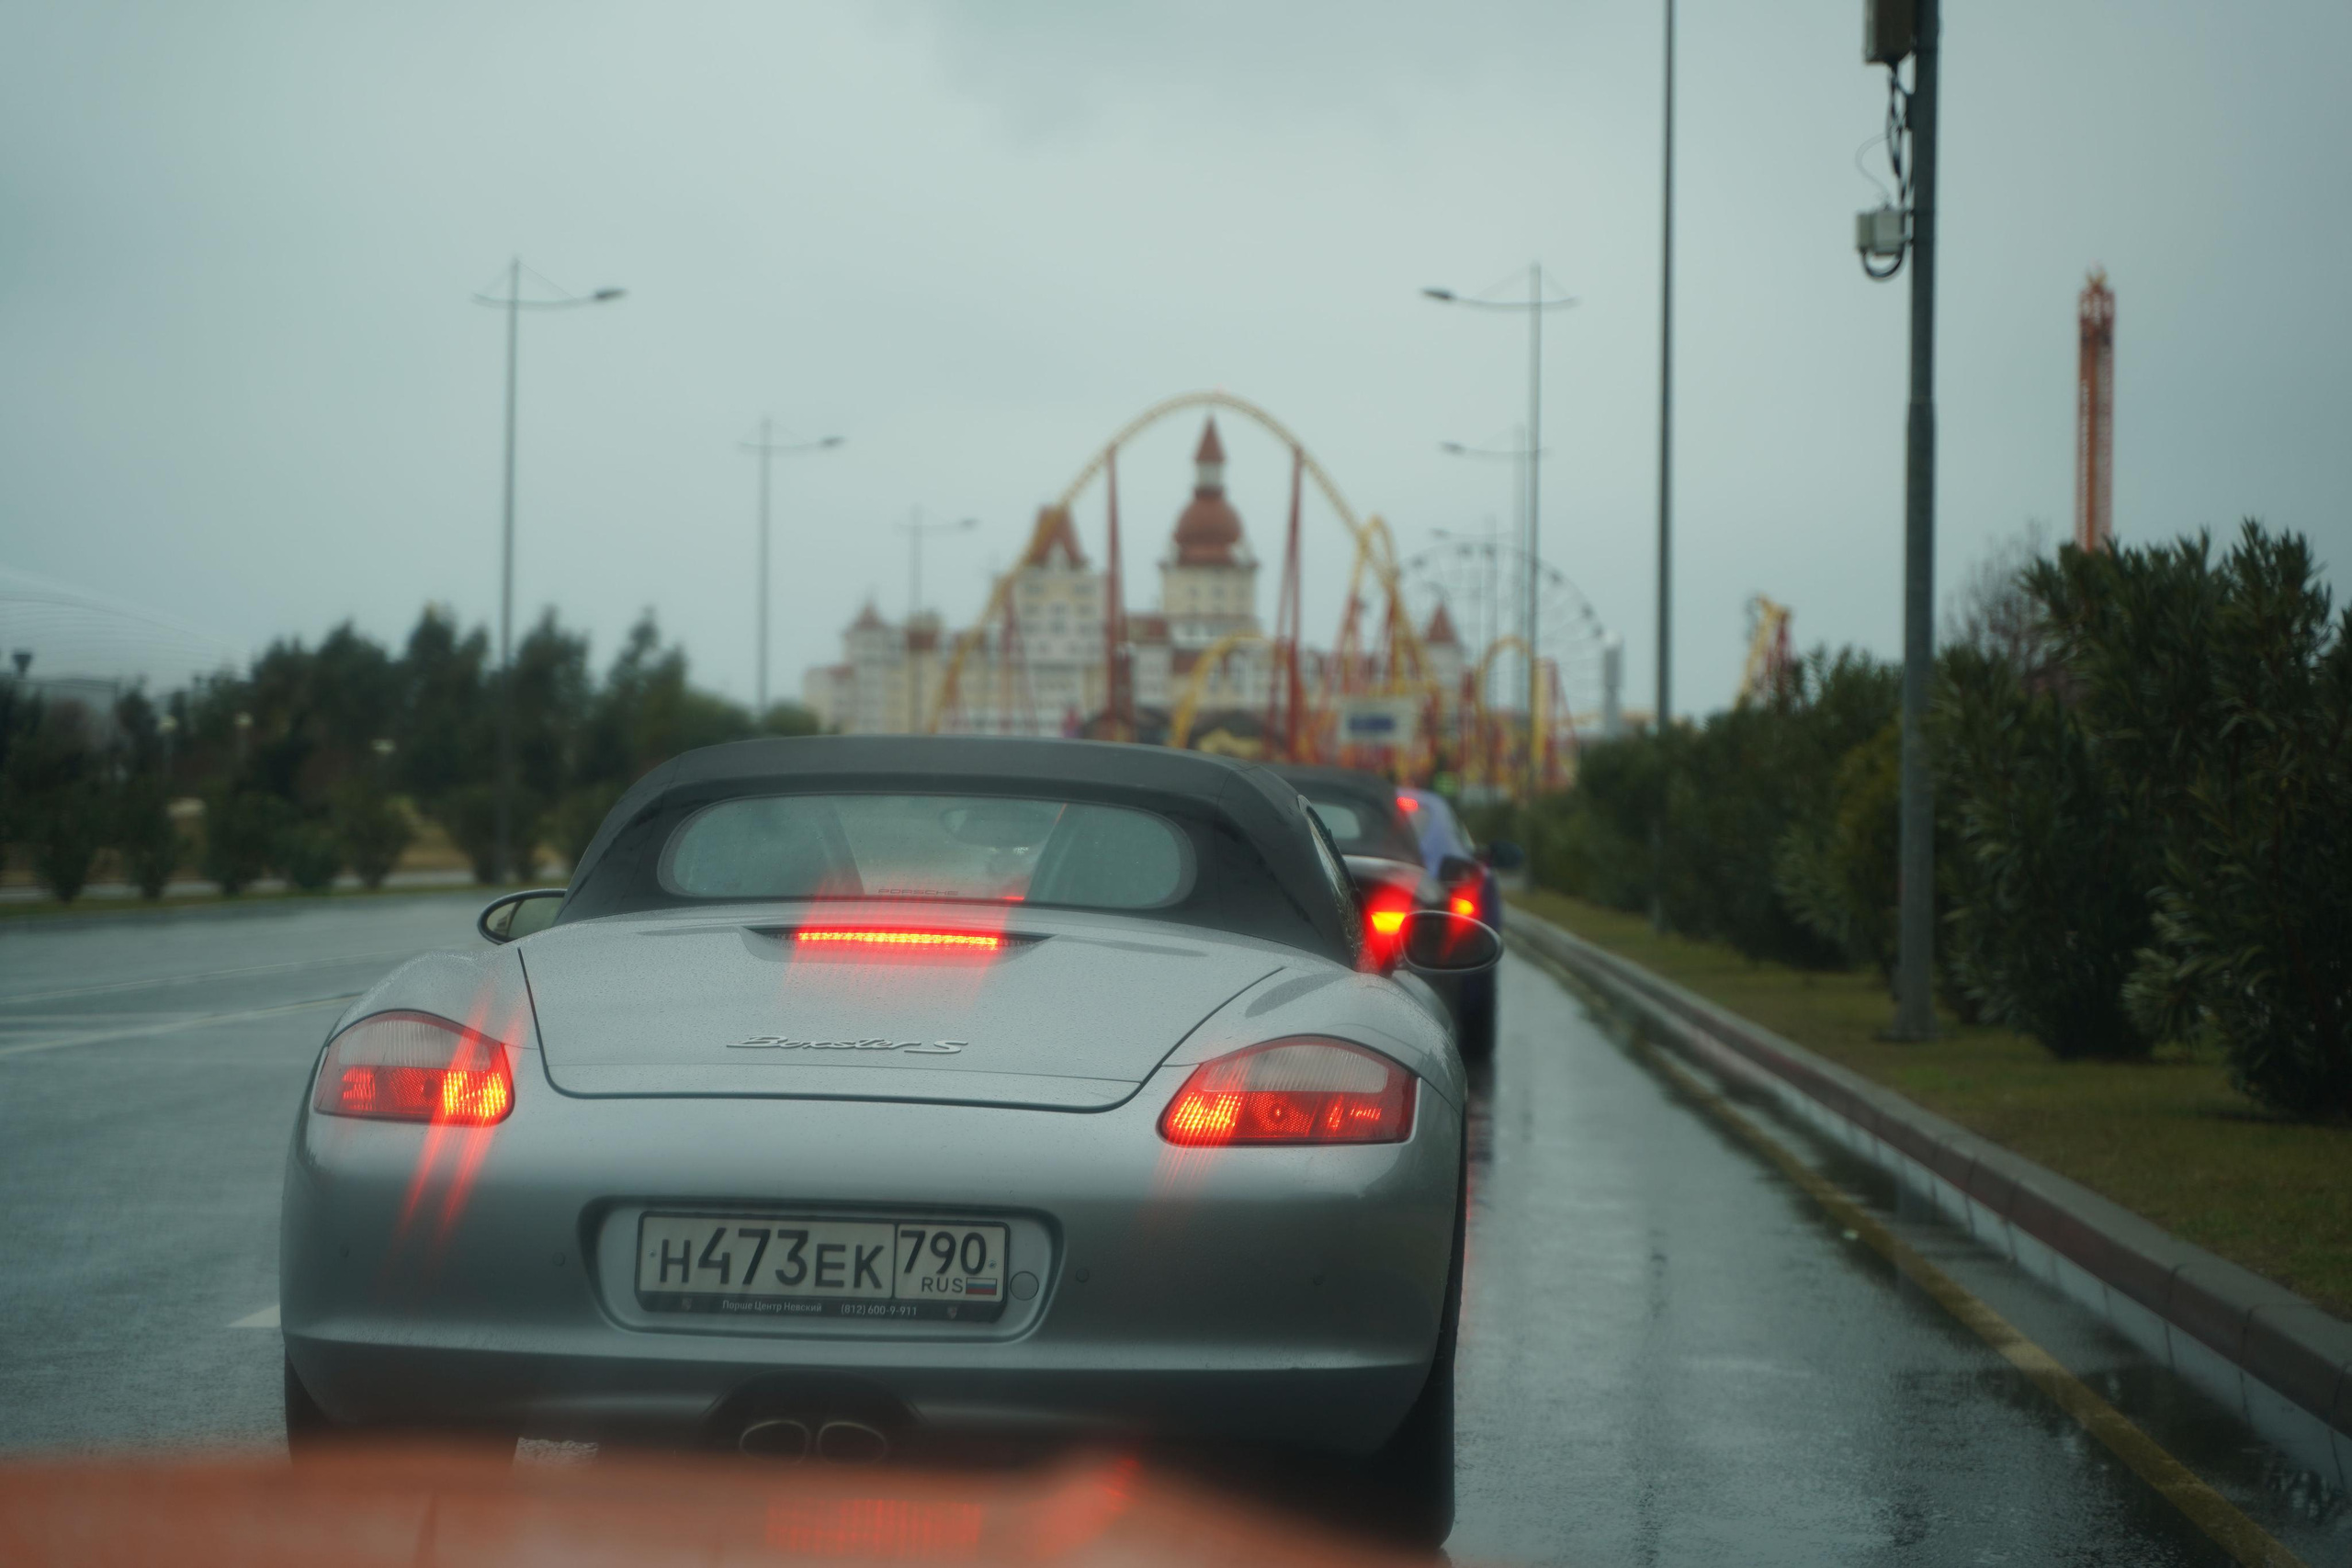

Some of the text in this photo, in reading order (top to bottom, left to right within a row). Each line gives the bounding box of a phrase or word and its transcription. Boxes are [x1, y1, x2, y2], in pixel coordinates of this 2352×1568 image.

[878, 888, 959, 897] PORSCHE
[726, 1035, 969, 1055] Boxster S
[899, 1229, 988, 1276] 790
[921, 1276, 964, 1293] RUS
[722, 1300, 918, 1316] Порше Центр Невский (812) 600-9-911
